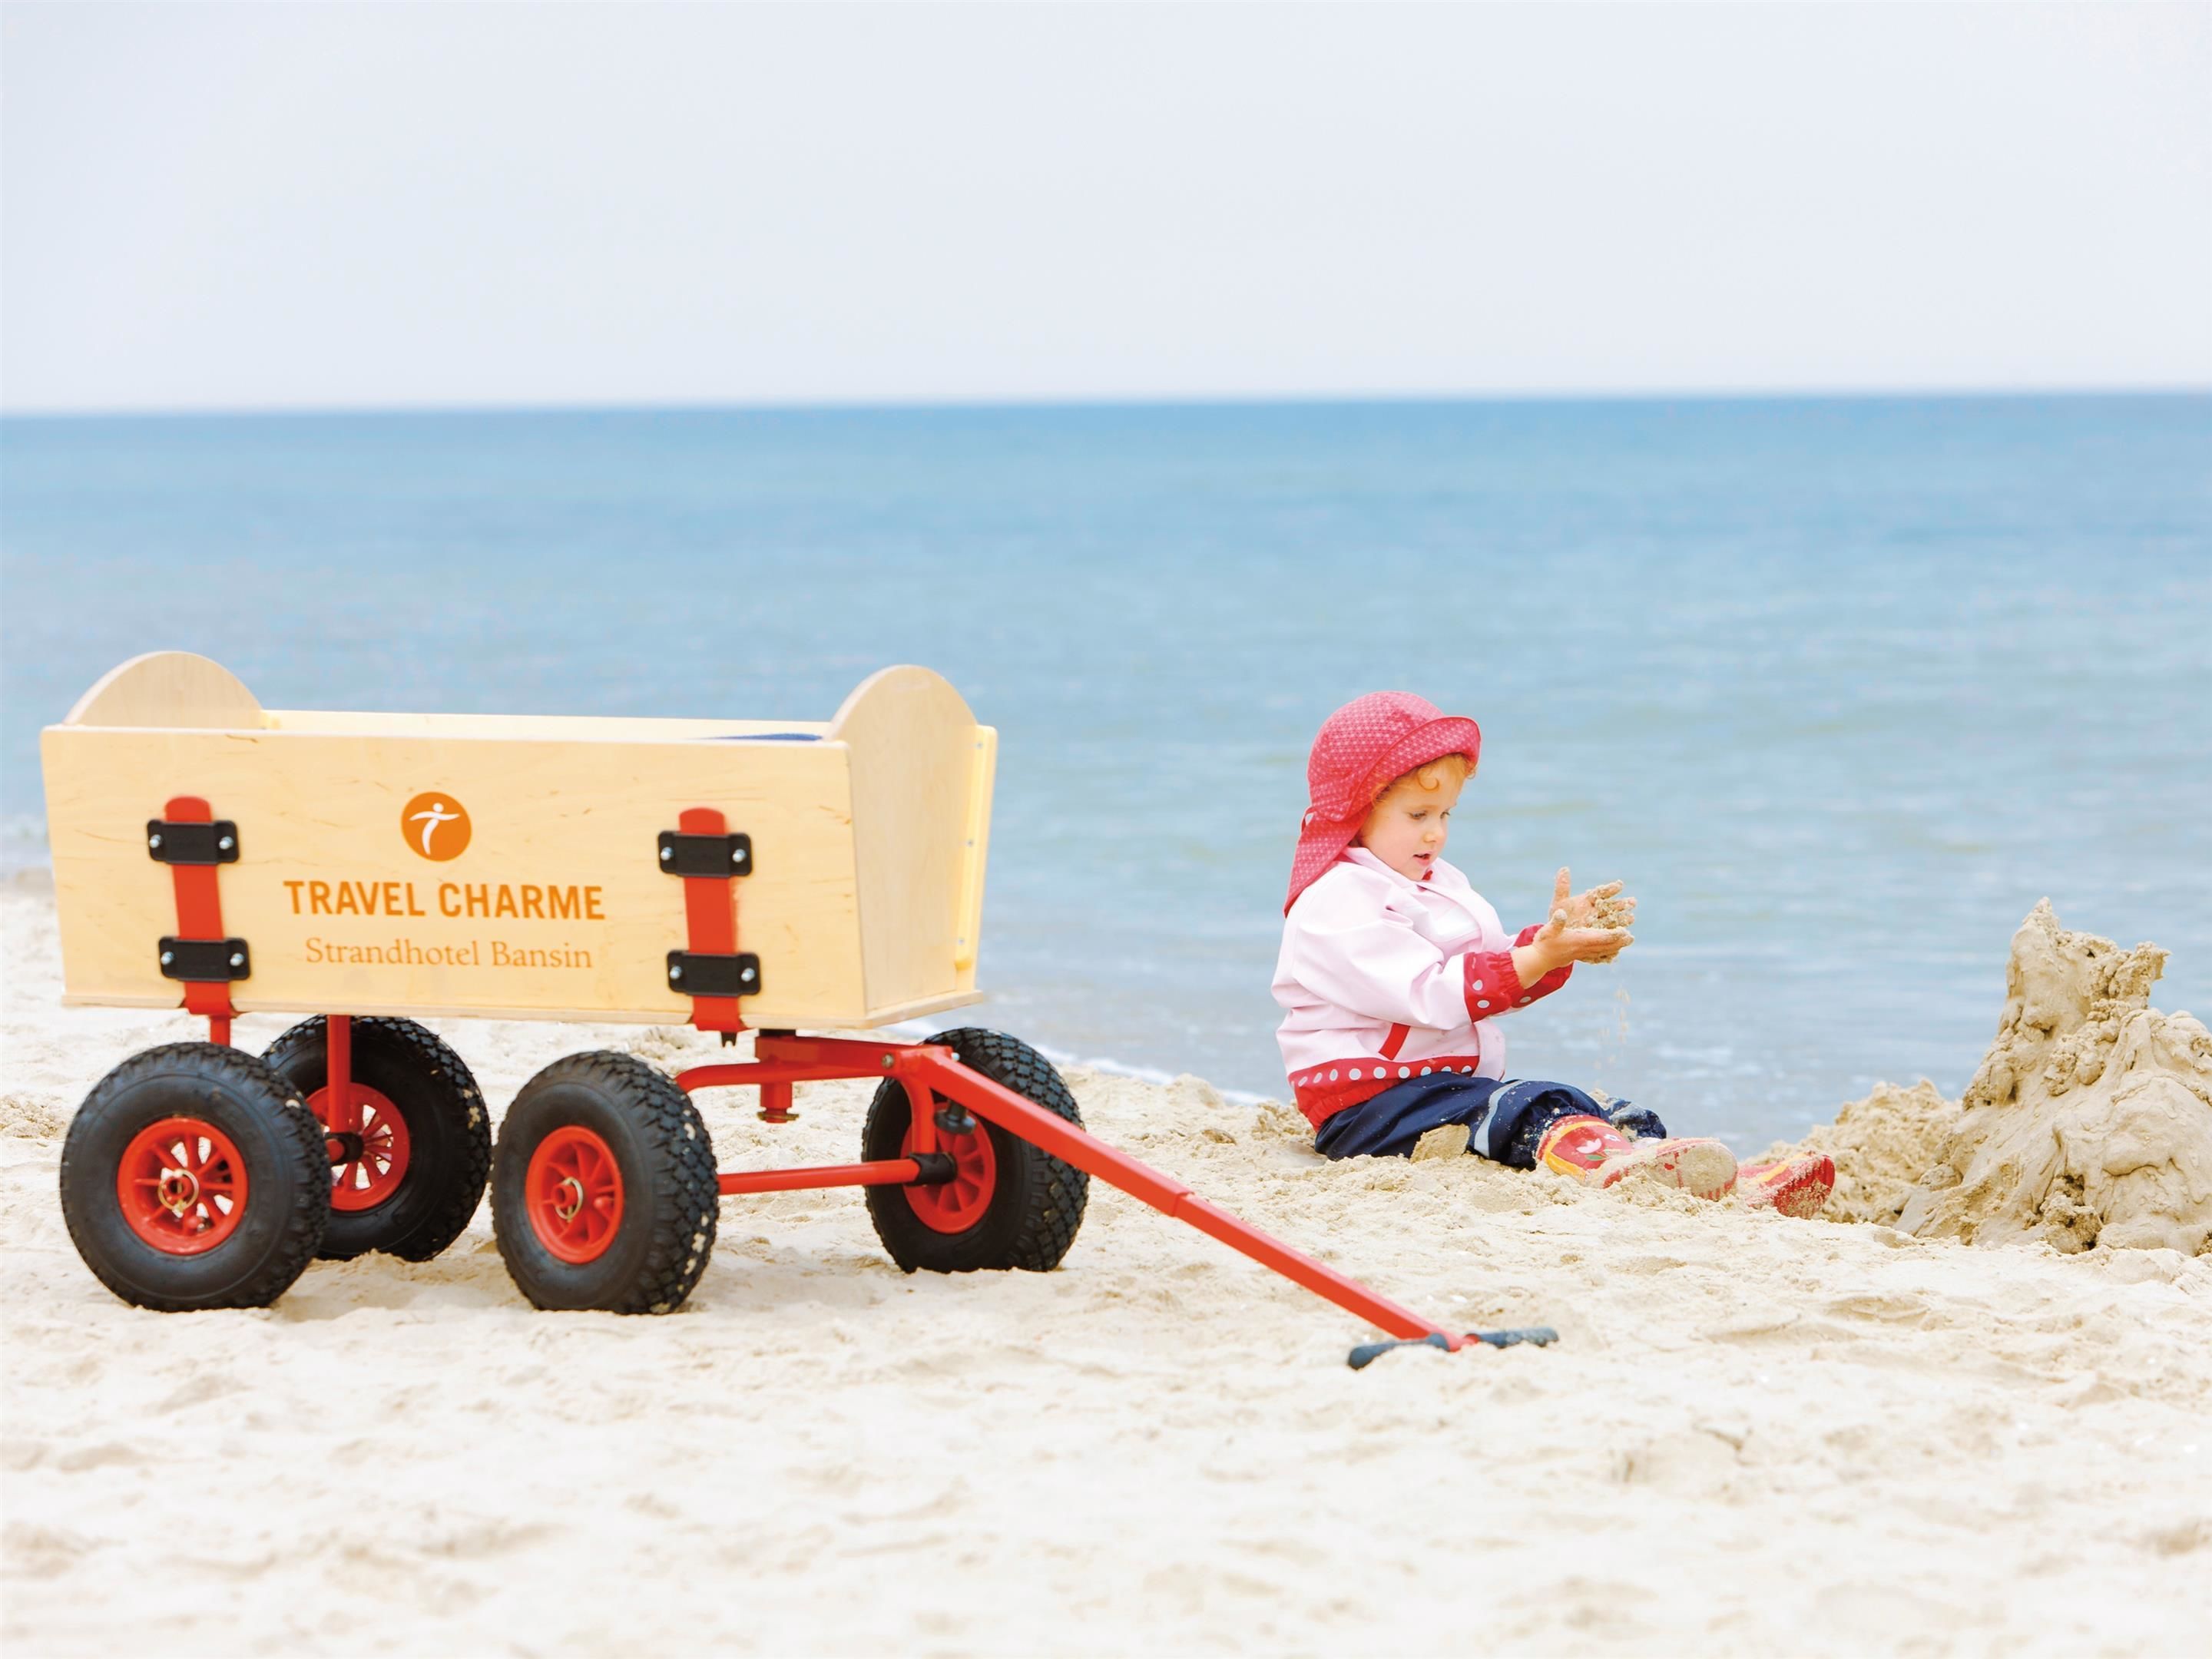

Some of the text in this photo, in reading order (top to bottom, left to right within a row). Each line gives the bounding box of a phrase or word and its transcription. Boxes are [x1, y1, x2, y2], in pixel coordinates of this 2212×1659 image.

[283, 880, 605, 920] TRAVEL CHARME
[306, 937, 593, 968] Strandhotel Bansin
